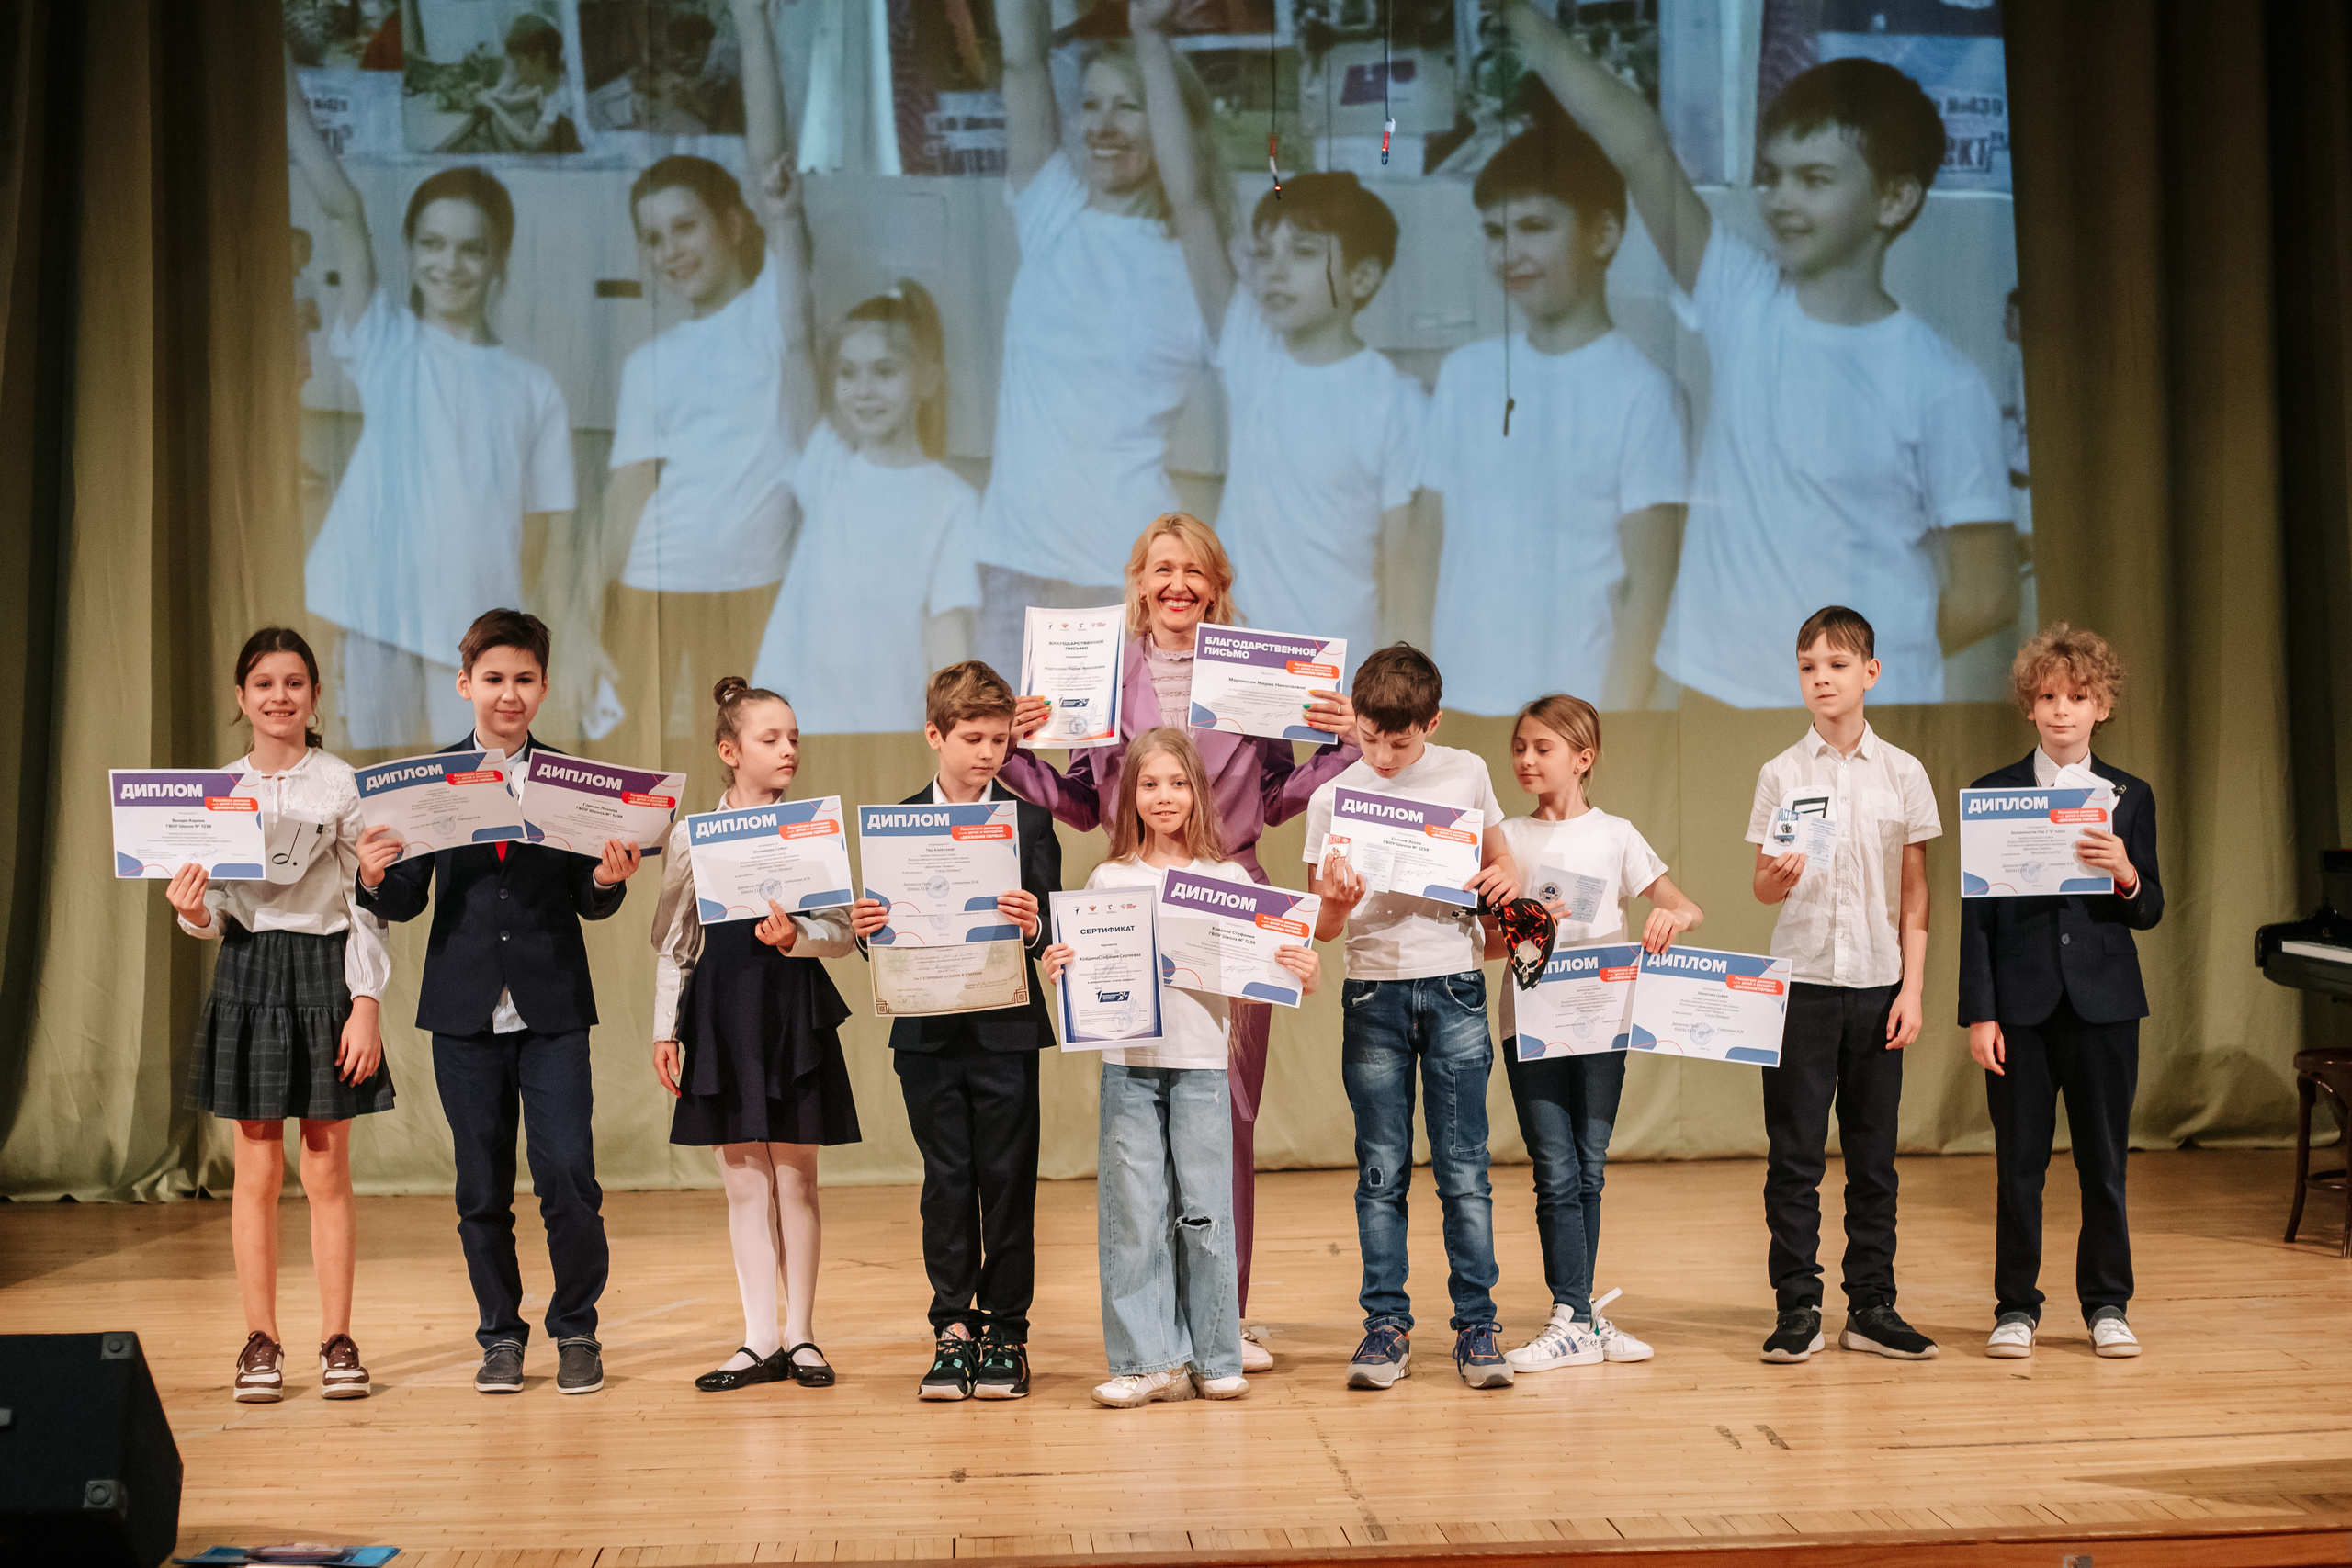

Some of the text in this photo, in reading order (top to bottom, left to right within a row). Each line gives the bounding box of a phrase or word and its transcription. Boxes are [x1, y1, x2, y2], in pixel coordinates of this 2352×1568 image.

[1204, 636, 1317, 657] БЛАГОДАРСТВЕННОЕ
[1204, 646, 1250, 660] ПИСЬМО
[366, 763, 444, 791] ДИПЛОМ
[537, 763, 623, 791] ДИПЛОМ
[120, 784, 203, 799] ДИПЛОМ
[1341, 798, 1424, 823] ДИПЛОМ
[1968, 796, 2049, 814] ДИПЛОМ
[695, 813, 777, 839] ДИПЛОМ
[867, 813, 950, 829] ДИПЛОМ
[1170, 882, 1257, 912] ДИПЛОМ
[1080, 925, 1135, 934] СЕРТИФИКАТ
[1544, 957, 1598, 974] ПЛОМ
[1647, 954, 1727, 973] ДИПЛОМ
